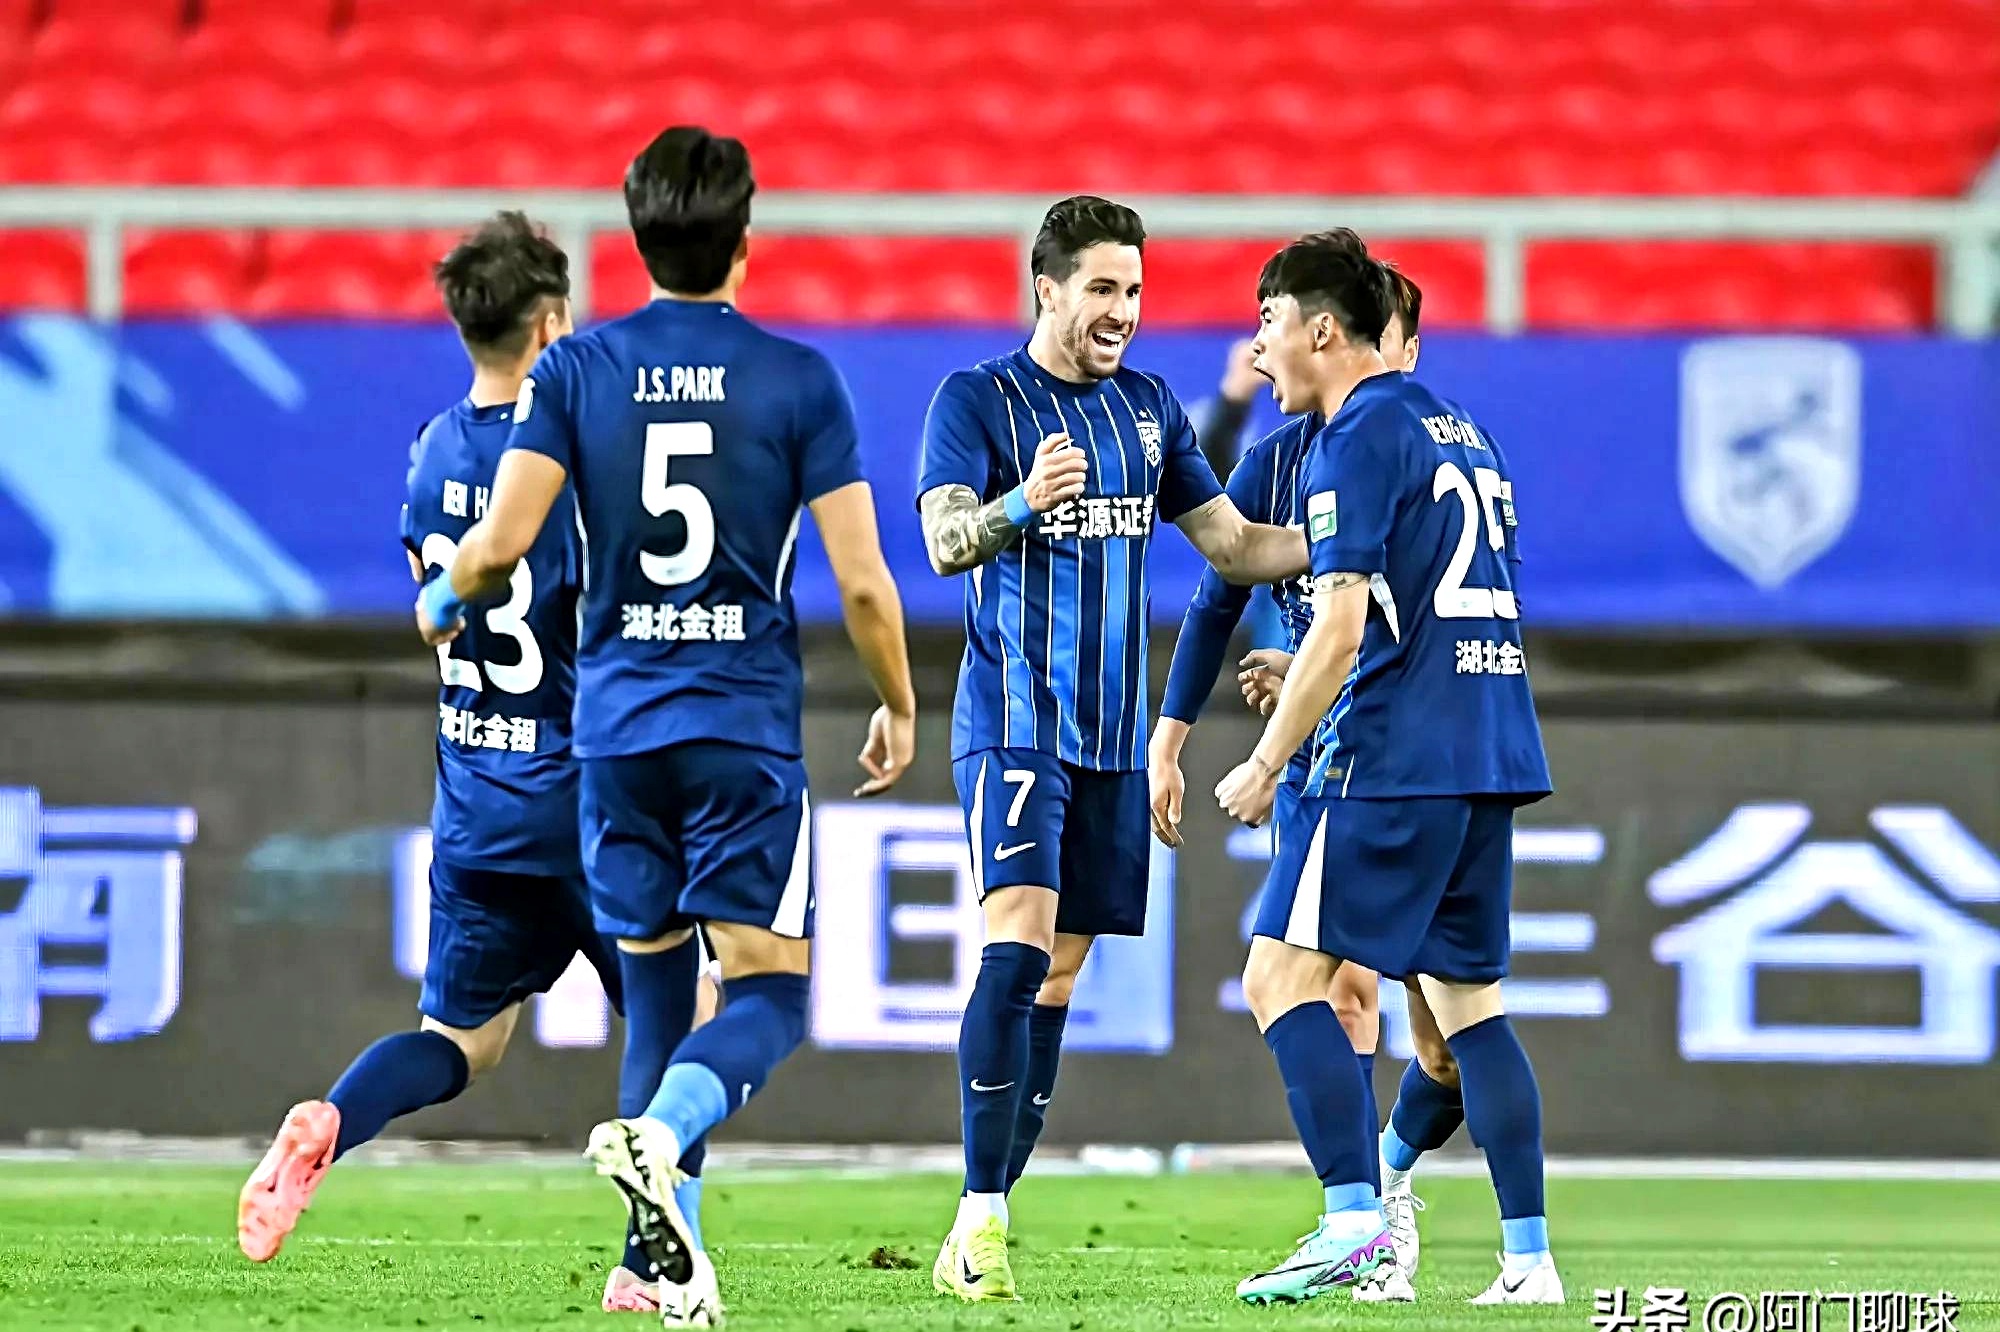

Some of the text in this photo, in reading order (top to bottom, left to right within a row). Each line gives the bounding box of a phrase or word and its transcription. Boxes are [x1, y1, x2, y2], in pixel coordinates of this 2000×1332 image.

[633, 366, 726, 402] J.S.PARK
[640, 421, 715, 586] 5
[1432, 461, 1519, 619] 25
[621, 603, 746, 641] 湖北金租
[1455, 639, 1525, 675] 湖北金
[1003, 769, 1036, 827] 7
